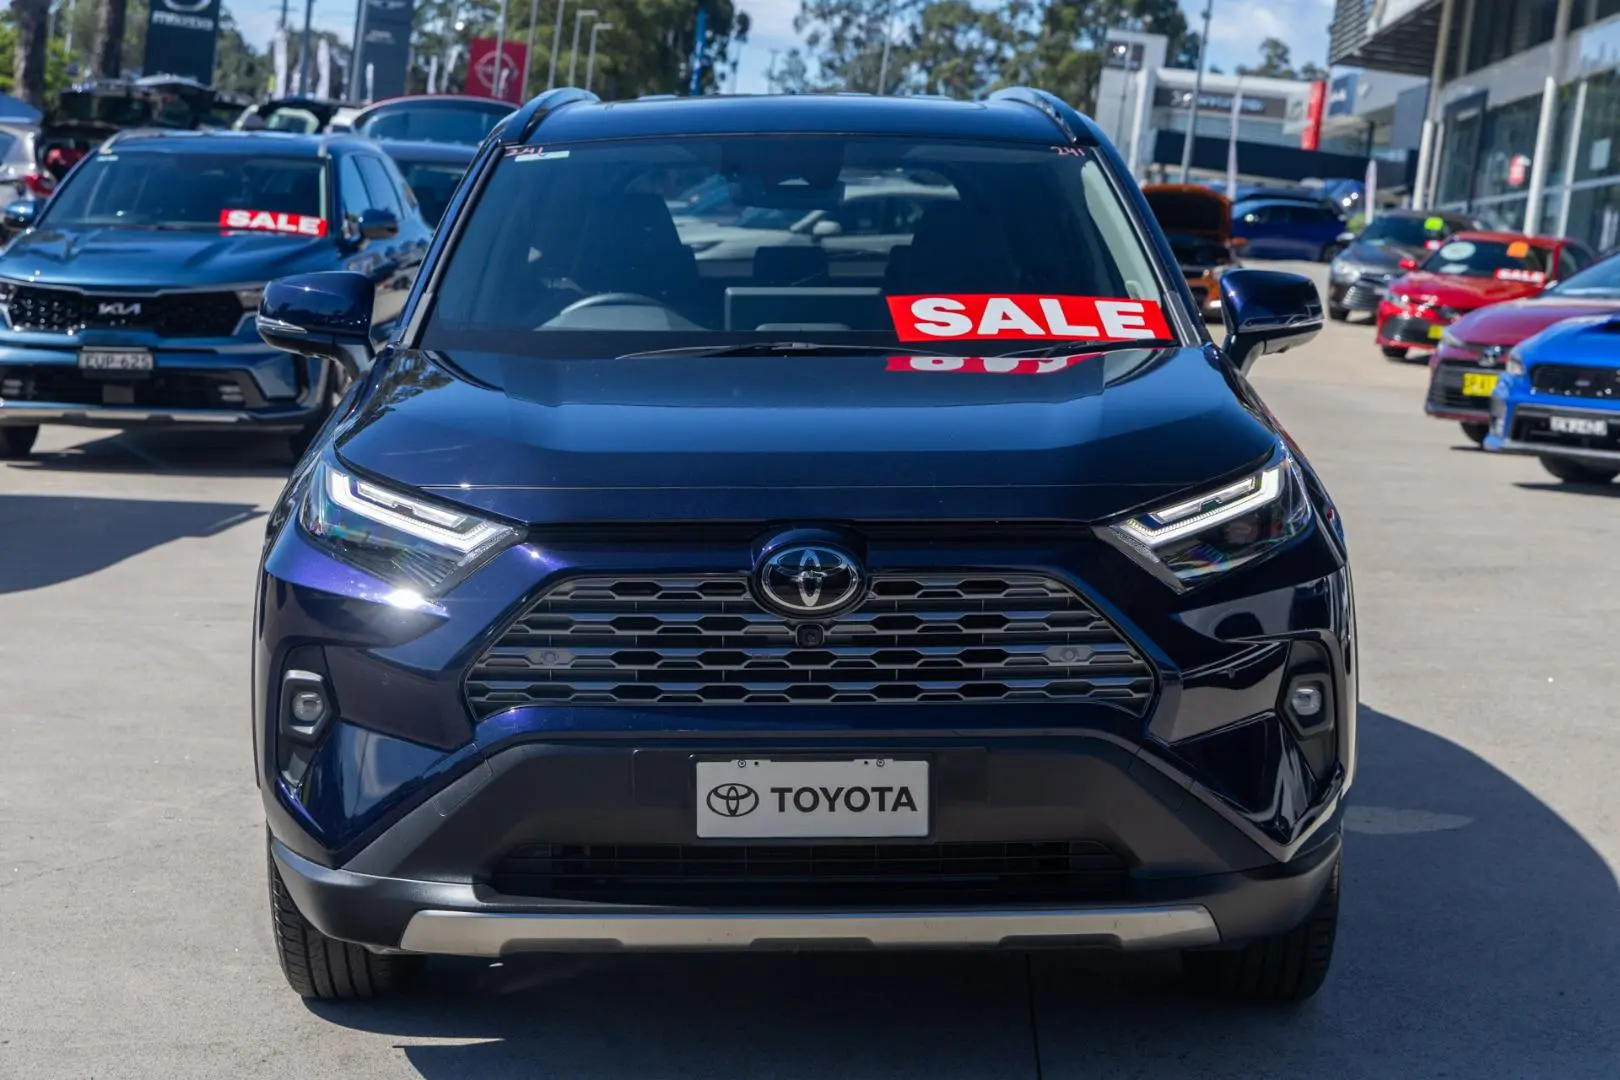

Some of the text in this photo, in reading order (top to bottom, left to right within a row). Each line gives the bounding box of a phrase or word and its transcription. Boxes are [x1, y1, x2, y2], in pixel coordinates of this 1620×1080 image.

[1050, 146, 1085, 157] 241
[226, 209, 320, 235] SALE
[910, 297, 1155, 339] SALE
[770, 786, 918, 813] TOYOTA
